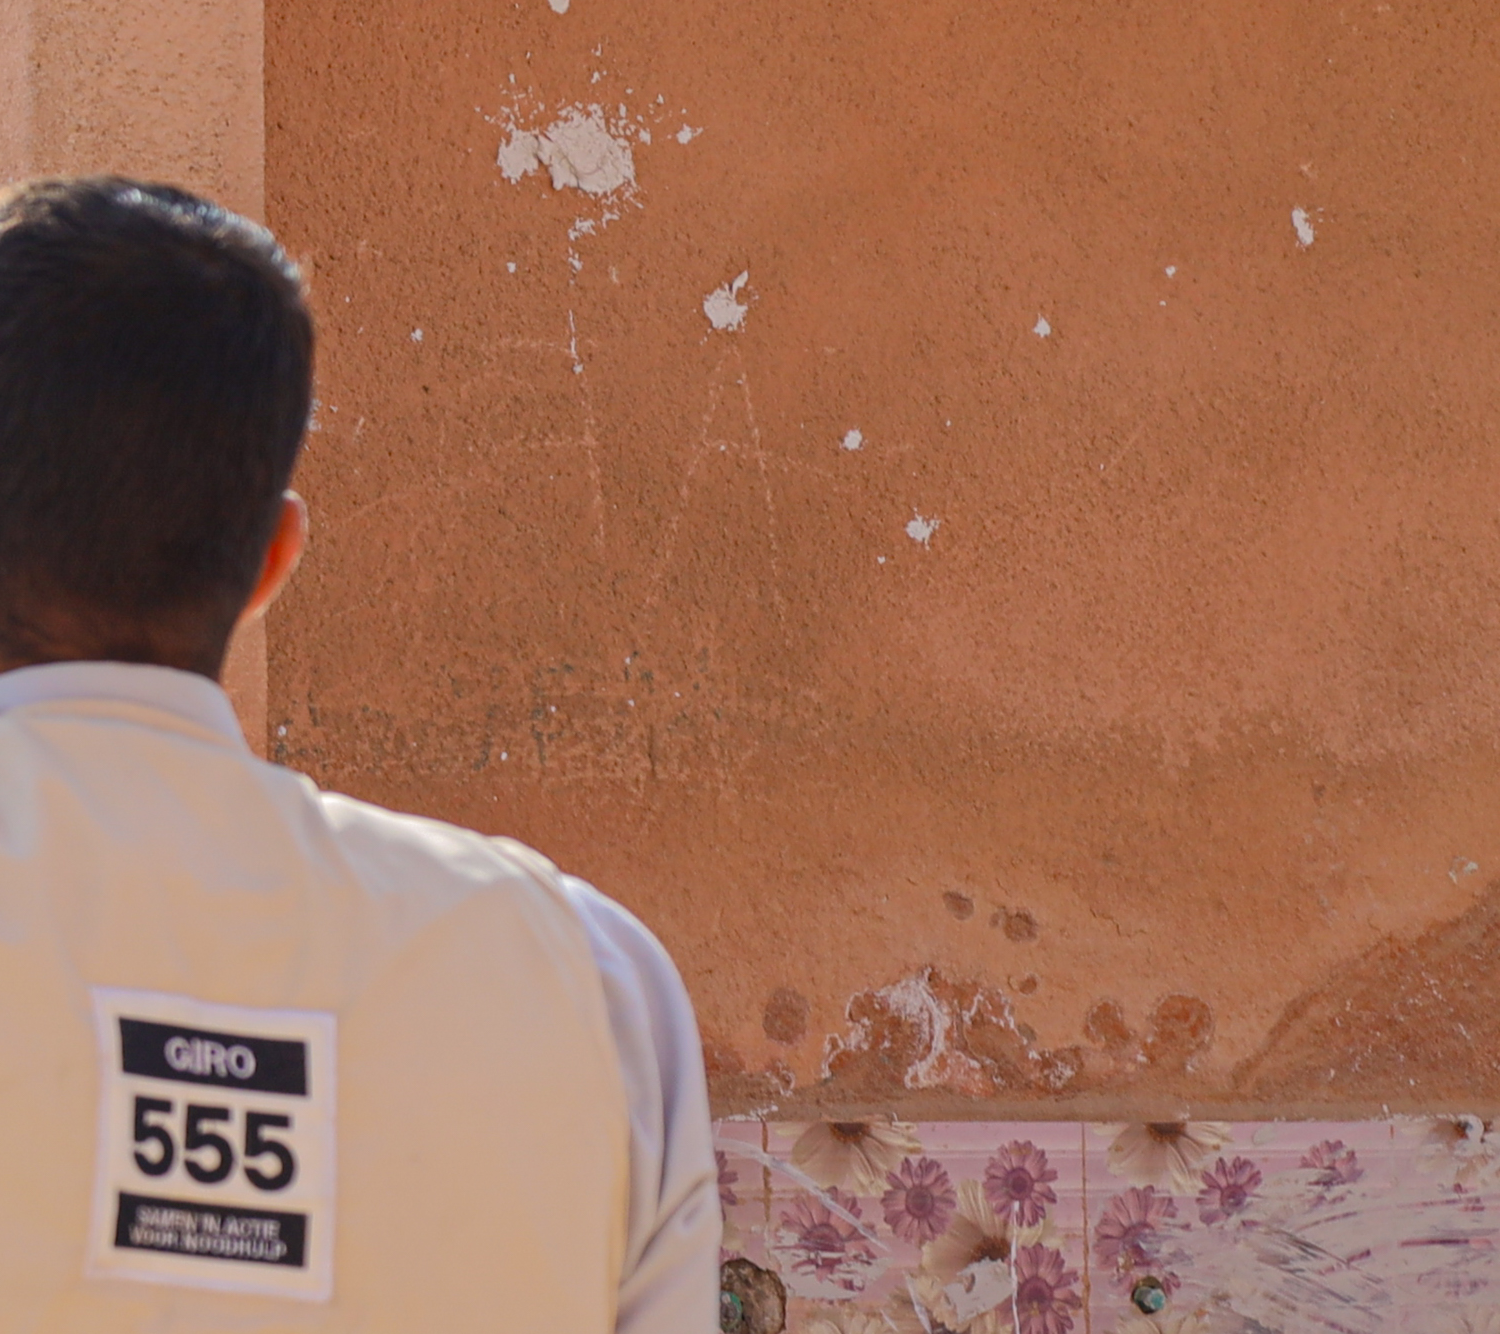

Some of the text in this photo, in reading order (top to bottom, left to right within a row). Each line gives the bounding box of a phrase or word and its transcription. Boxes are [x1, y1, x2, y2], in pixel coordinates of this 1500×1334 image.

[164, 1035, 256, 1080] GIRO
[133, 1095, 295, 1192] 555
[201, 1211, 221, 1235] IN
